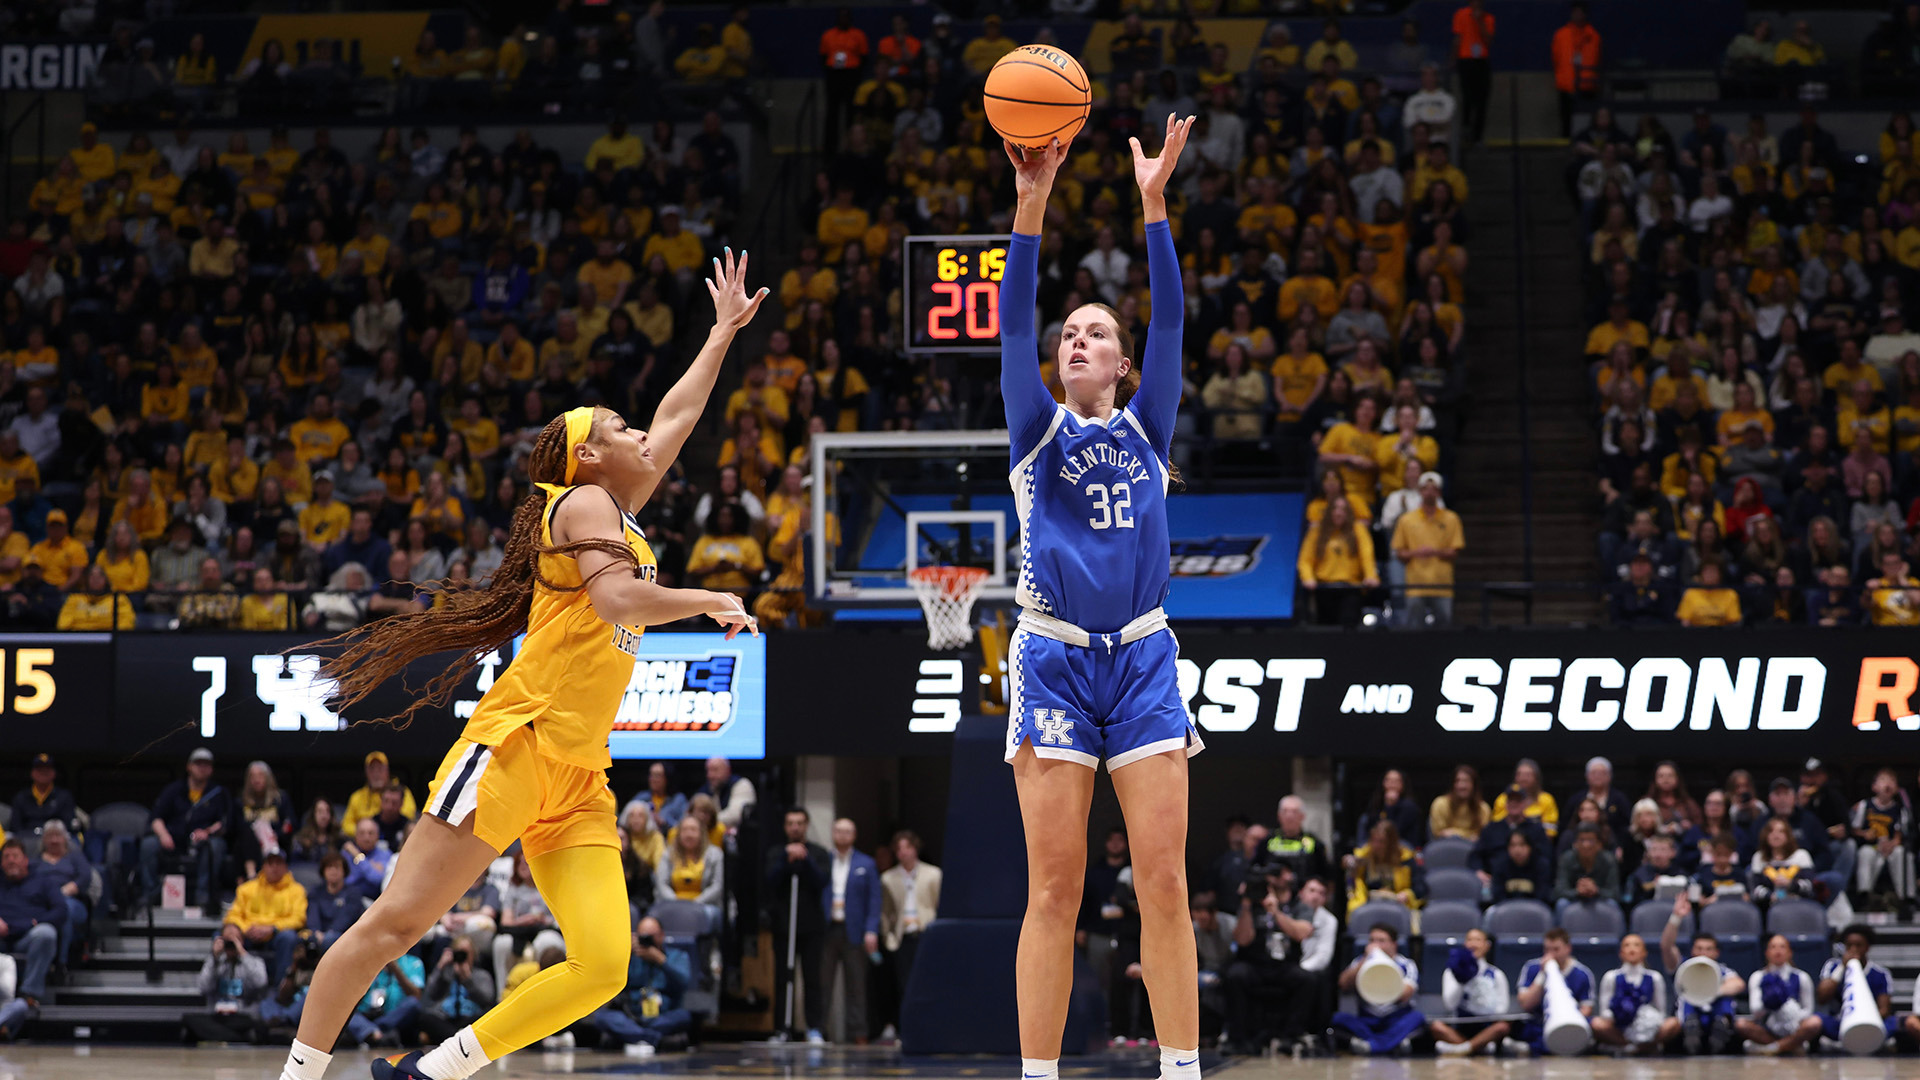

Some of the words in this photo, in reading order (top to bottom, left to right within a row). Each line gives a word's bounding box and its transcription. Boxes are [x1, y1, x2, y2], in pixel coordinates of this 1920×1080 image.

[938, 248, 1006, 281] 6:15
[928, 282, 999, 339] 20
[1059, 443, 1150, 485] KENTUCKY
[1085, 483, 1134, 530] 32
[0, 648, 56, 715] 5
[192, 656, 226, 737] 7
[1340, 684, 1413, 714] AND
[1435, 657, 1827, 732] SECOND
[1033, 708, 1074, 746] UK
